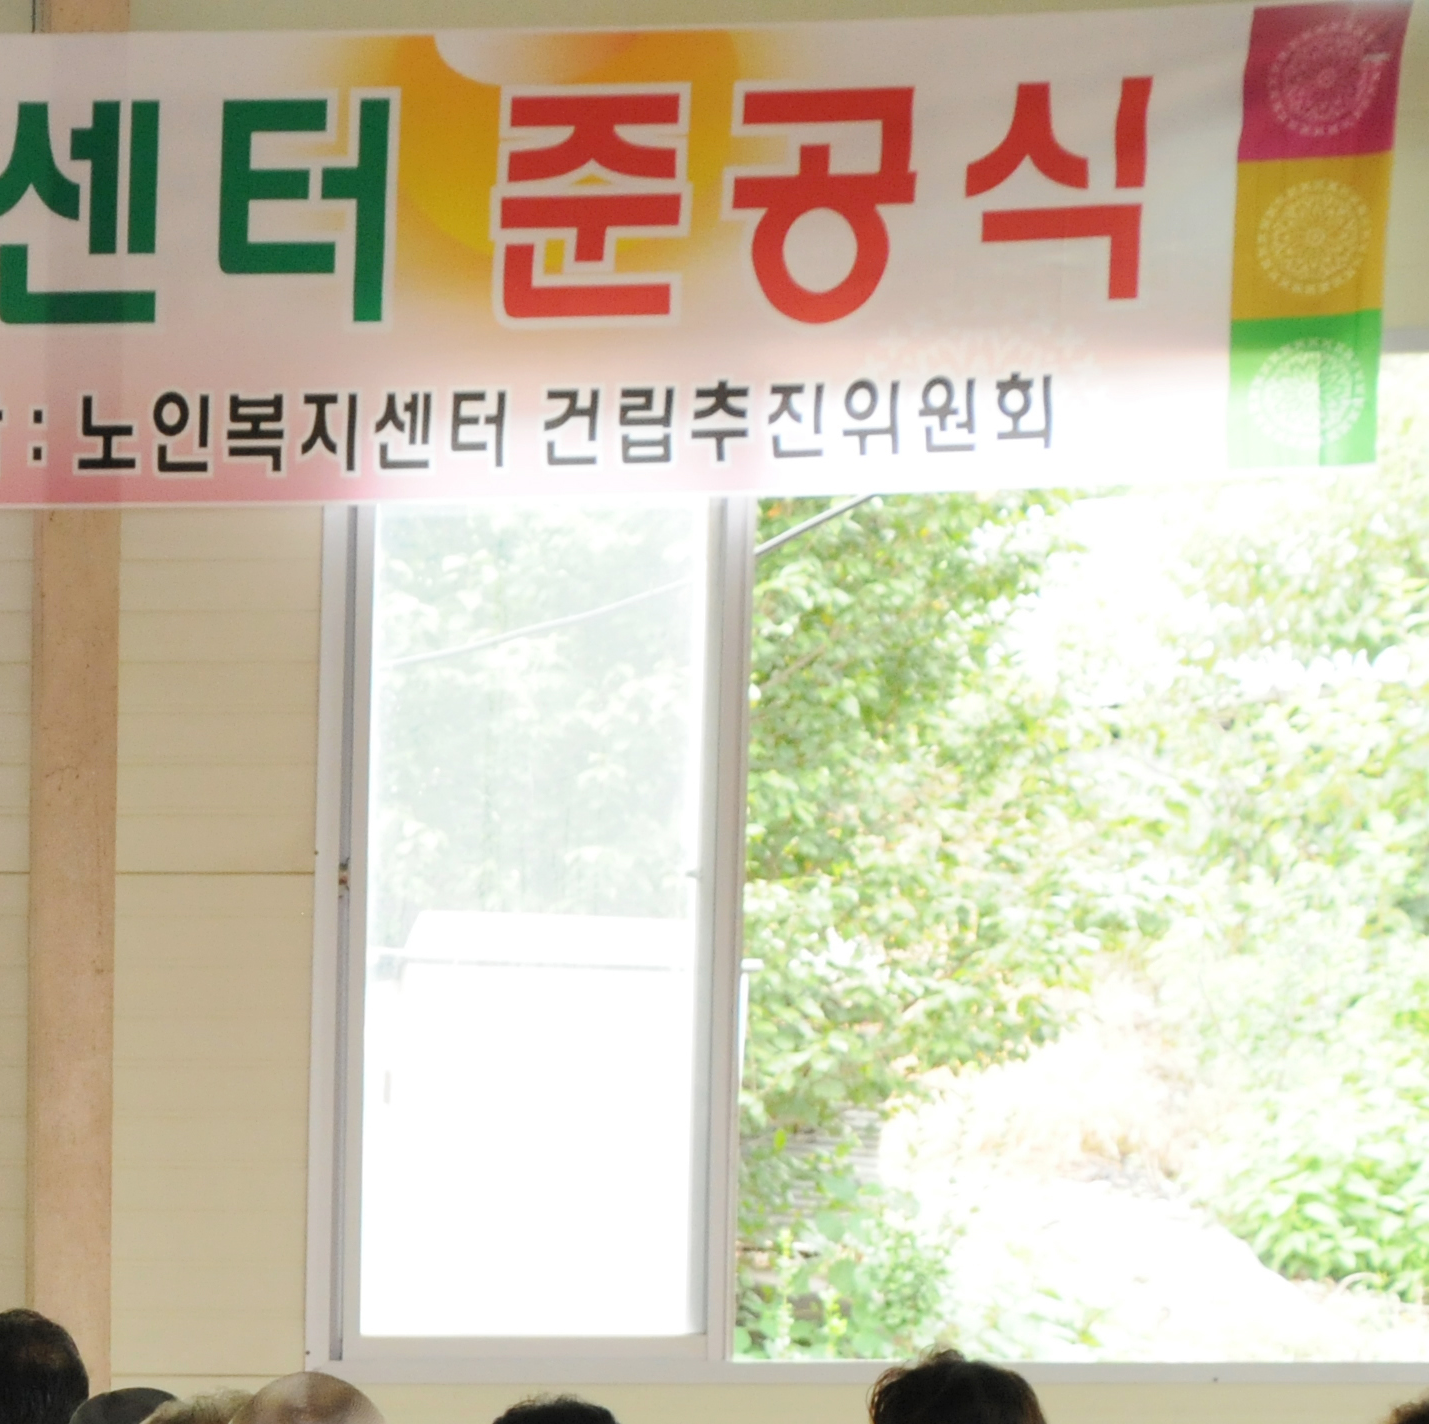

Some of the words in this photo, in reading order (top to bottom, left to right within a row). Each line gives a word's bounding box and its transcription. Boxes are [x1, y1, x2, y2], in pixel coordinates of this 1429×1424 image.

[500, 75, 1154, 325] 준공식
[76, 391, 508, 473] 노인복지센터
[542, 371, 1055, 469] 건립추진위원회
